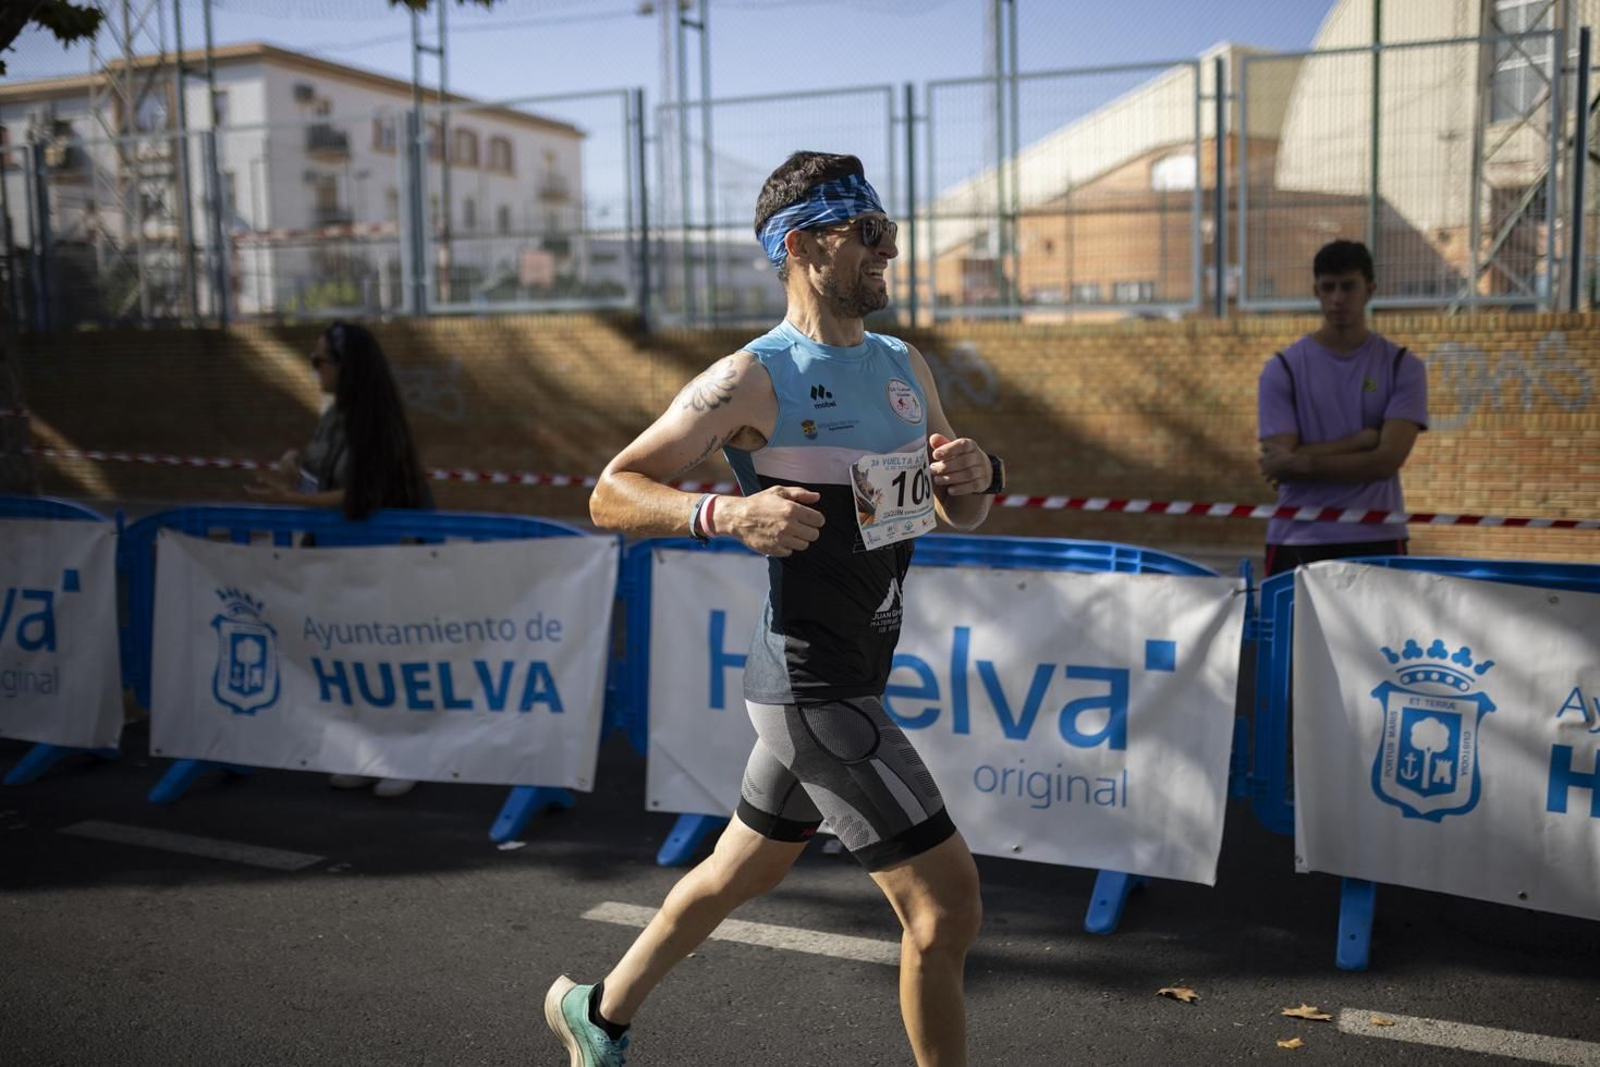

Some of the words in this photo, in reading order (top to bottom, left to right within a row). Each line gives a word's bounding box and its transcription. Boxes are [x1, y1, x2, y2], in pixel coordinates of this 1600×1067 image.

[883, 456, 913, 465] VUELTA
[304, 612, 516, 646] Ayuntamiento
[526, 612, 563, 642] de
[311, 657, 565, 713] HUELVA
[709, 610, 1129, 751] Helva
[1409, 697, 1421, 706] ET
[974, 759, 1128, 810] original
